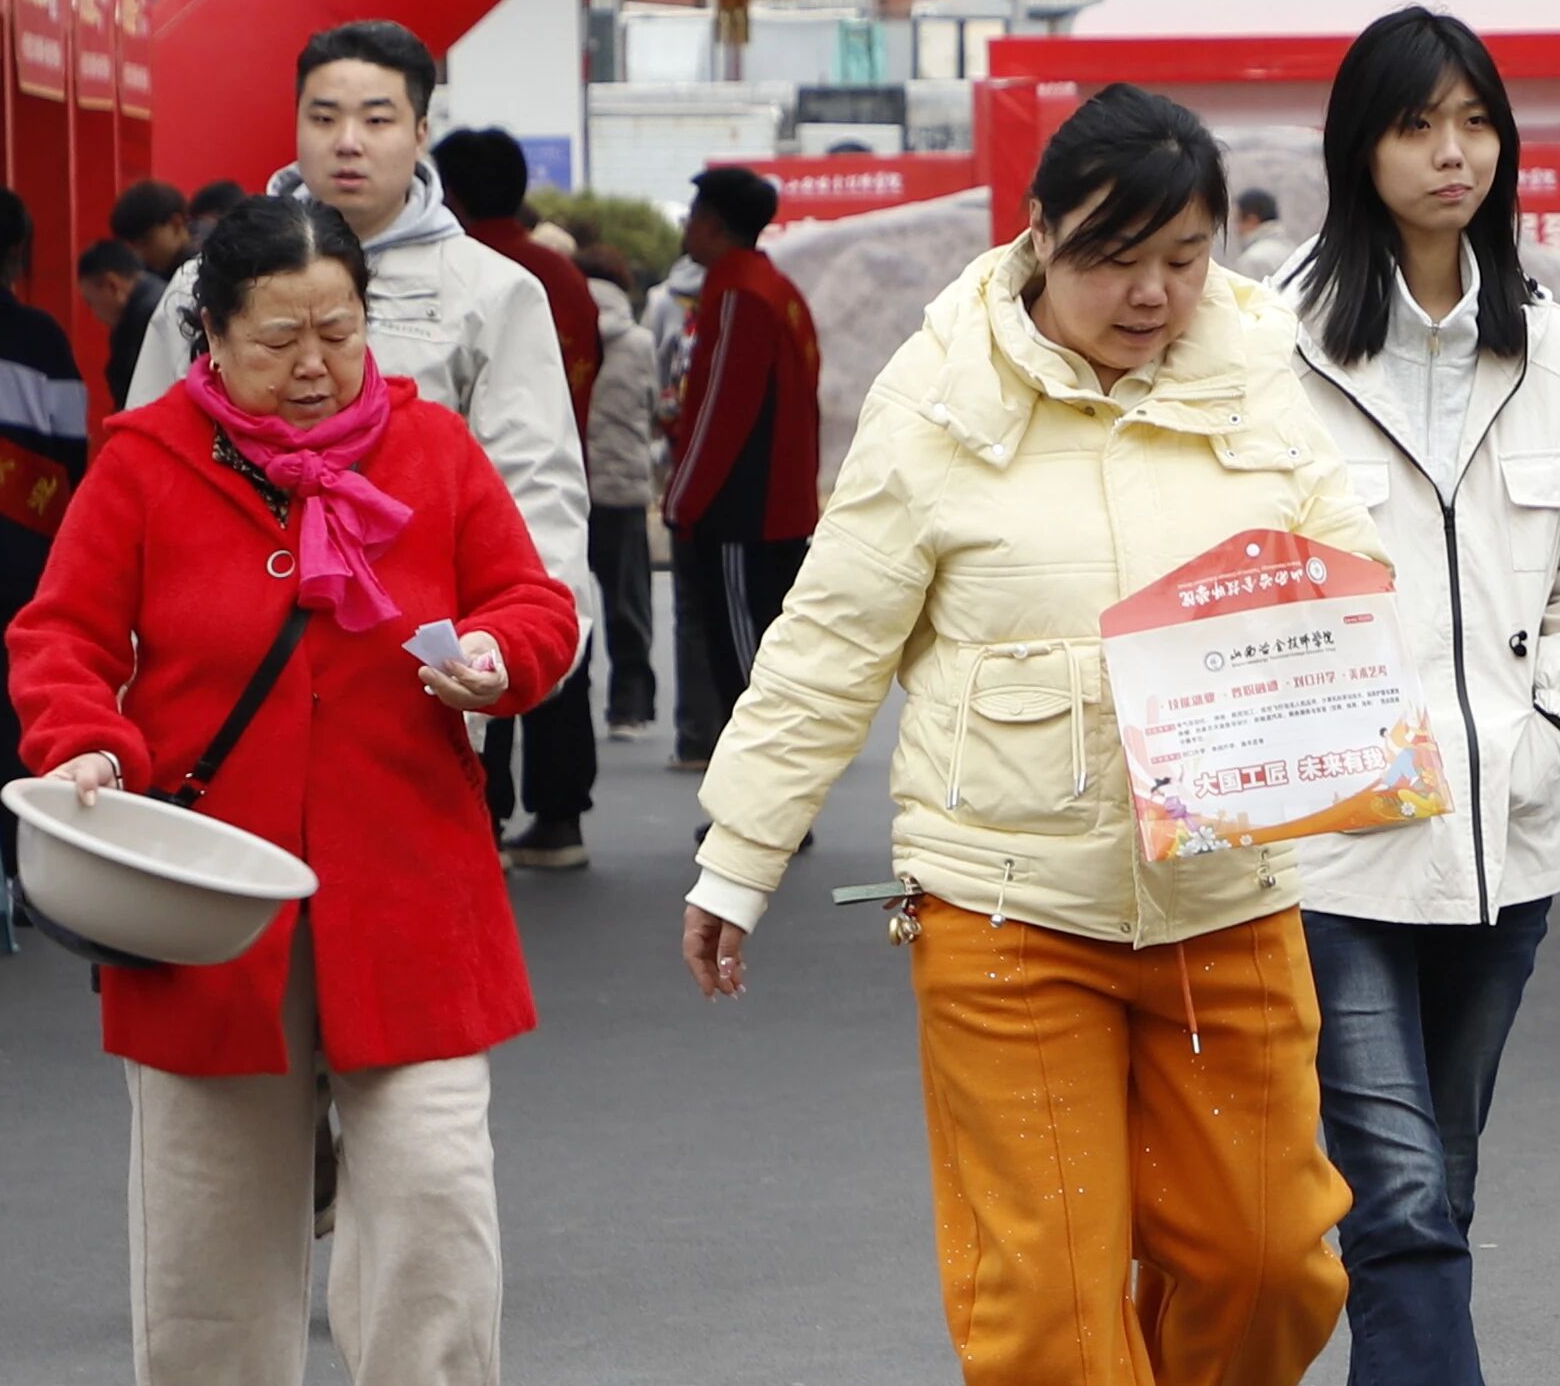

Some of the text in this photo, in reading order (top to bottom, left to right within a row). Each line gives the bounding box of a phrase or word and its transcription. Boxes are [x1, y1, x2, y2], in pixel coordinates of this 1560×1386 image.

[1194, 745, 1388, 798] 大国工匠 未来有我
